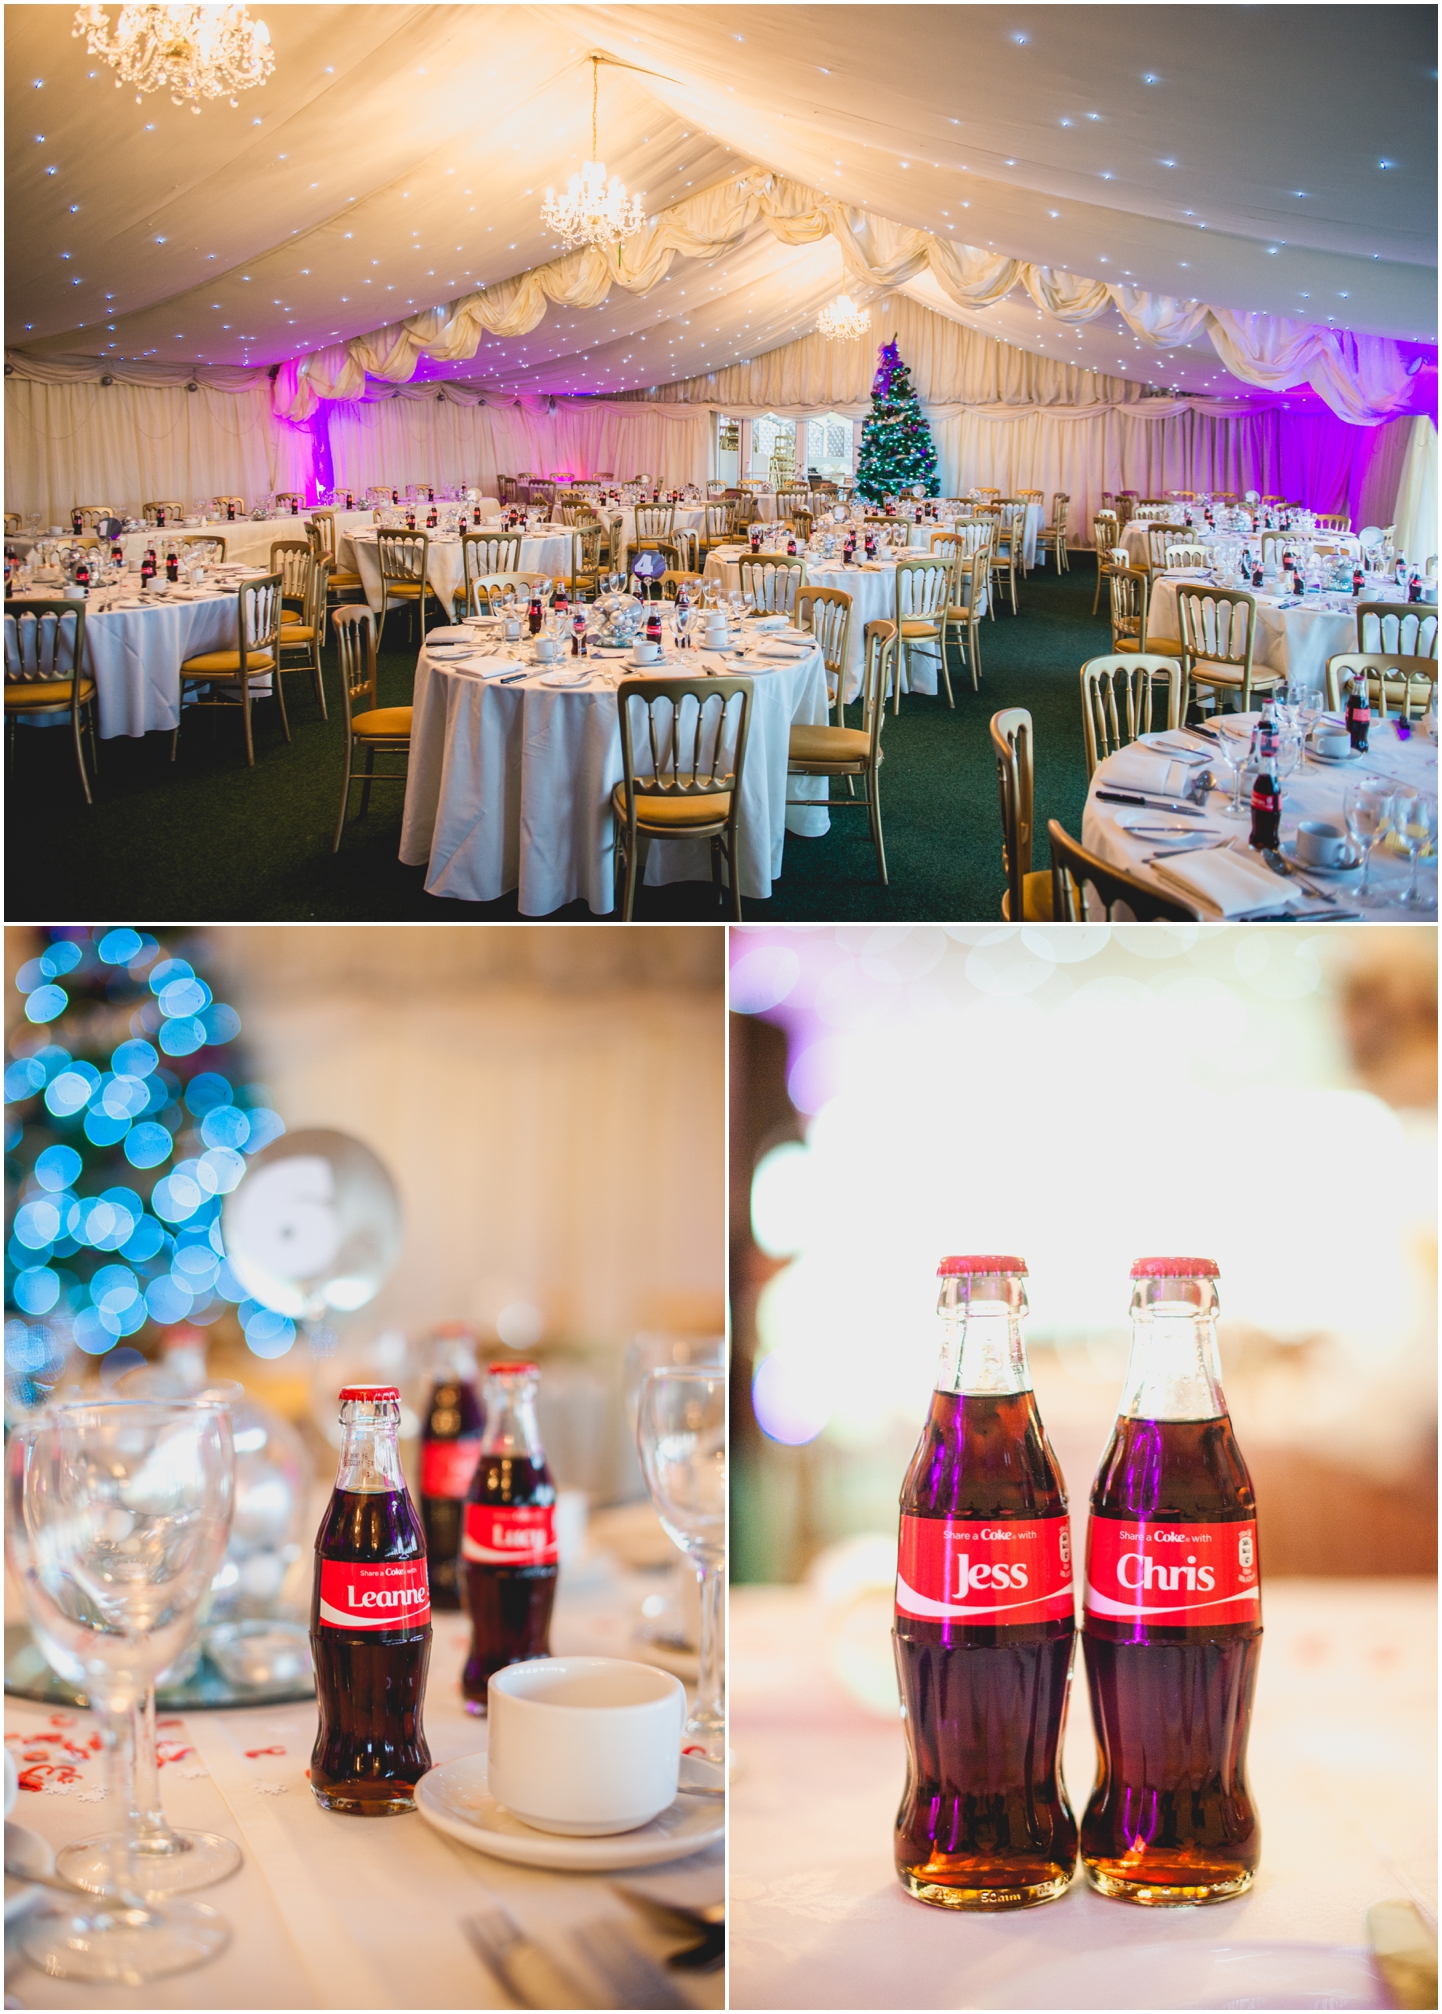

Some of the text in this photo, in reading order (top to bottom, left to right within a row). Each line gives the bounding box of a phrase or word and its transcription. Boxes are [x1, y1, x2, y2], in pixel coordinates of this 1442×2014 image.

[834, 506, 845, 520] 5
[99, 520, 108, 536] 1
[634, 553, 654, 575] 4
[230, 1157, 339, 1276] 6
[491, 1522, 548, 1551] Lucy
[943, 1529, 970, 1541] Share
[972, 1533, 979, 1541] a
[1018, 1530, 1037, 1540] with
[1119, 1530, 1144, 1541] Share
[1146, 1533, 1152, 1542] a
[1191, 1532, 1212, 1542] with
[360, 1568, 379, 1577] Share
[406, 1566, 418, 1575] with
[952, 1553, 1029, 1599] Jess
[1116, 1552, 1216, 1592] Chris
[347, 1584, 426, 1608] Leanne
